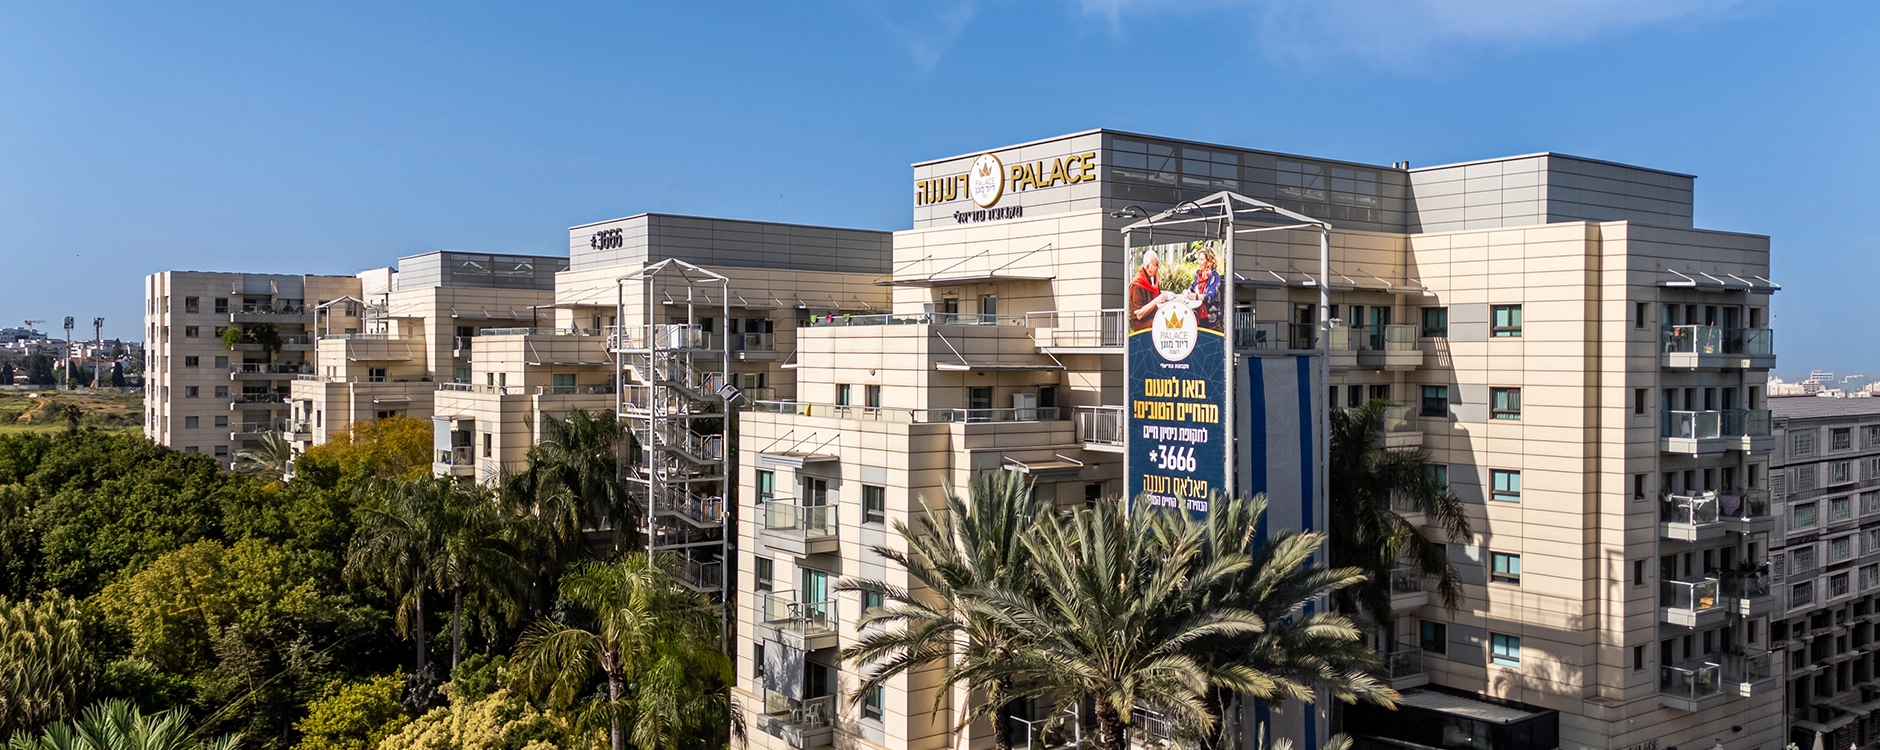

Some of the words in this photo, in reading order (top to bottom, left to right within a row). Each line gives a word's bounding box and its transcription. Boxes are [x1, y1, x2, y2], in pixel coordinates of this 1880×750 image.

[1011, 152, 1095, 191] PALACE
[916, 174, 969, 205] רעננה
[1160, 331, 1188, 340] PALACE
[1174, 340, 1188, 349] דיור
[1144, 376, 1180, 398] לטעום
[1182, 379, 1207, 399] בואו
[1133, 400, 1175, 421] הטובים!
[1176, 402, 1219, 424] מהחיים
[1159, 426, 1177, 442] ניסיון
[1179, 427, 1208, 445] לתקופת
[1143, 474, 1171, 494] רעננה
[1173, 476, 1208, 499] פאלאס
